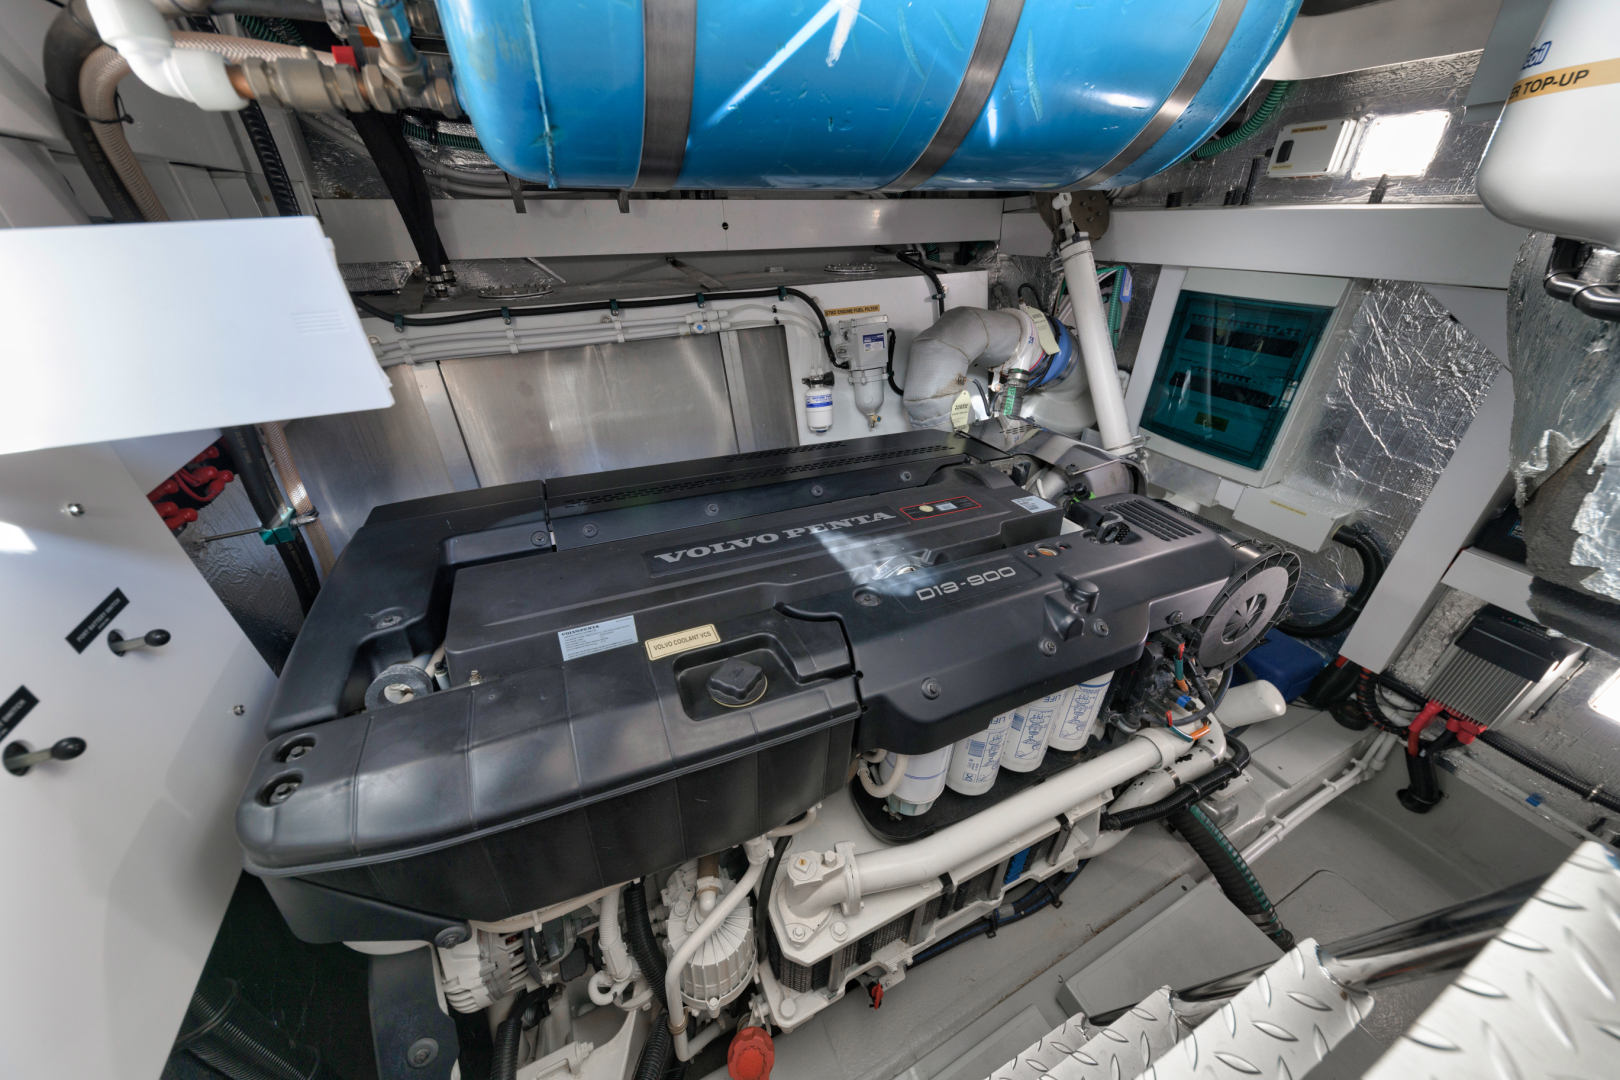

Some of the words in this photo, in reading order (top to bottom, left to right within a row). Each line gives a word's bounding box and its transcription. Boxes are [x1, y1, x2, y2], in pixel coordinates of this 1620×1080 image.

[1523, 69, 1590, 95] TOP-UP
[654, 533, 780, 563] VOLVO
[781, 511, 897, 540] PENTA
[916, 566, 1016, 601] D13-900
[87, 610, 108, 631] BATTERY
[104, 597, 121, 614] SWITCH
[653, 641, 673, 651] VOLVO
[673, 634, 699, 646] COOLANT
[1043, 693, 1062, 703] LIFE
